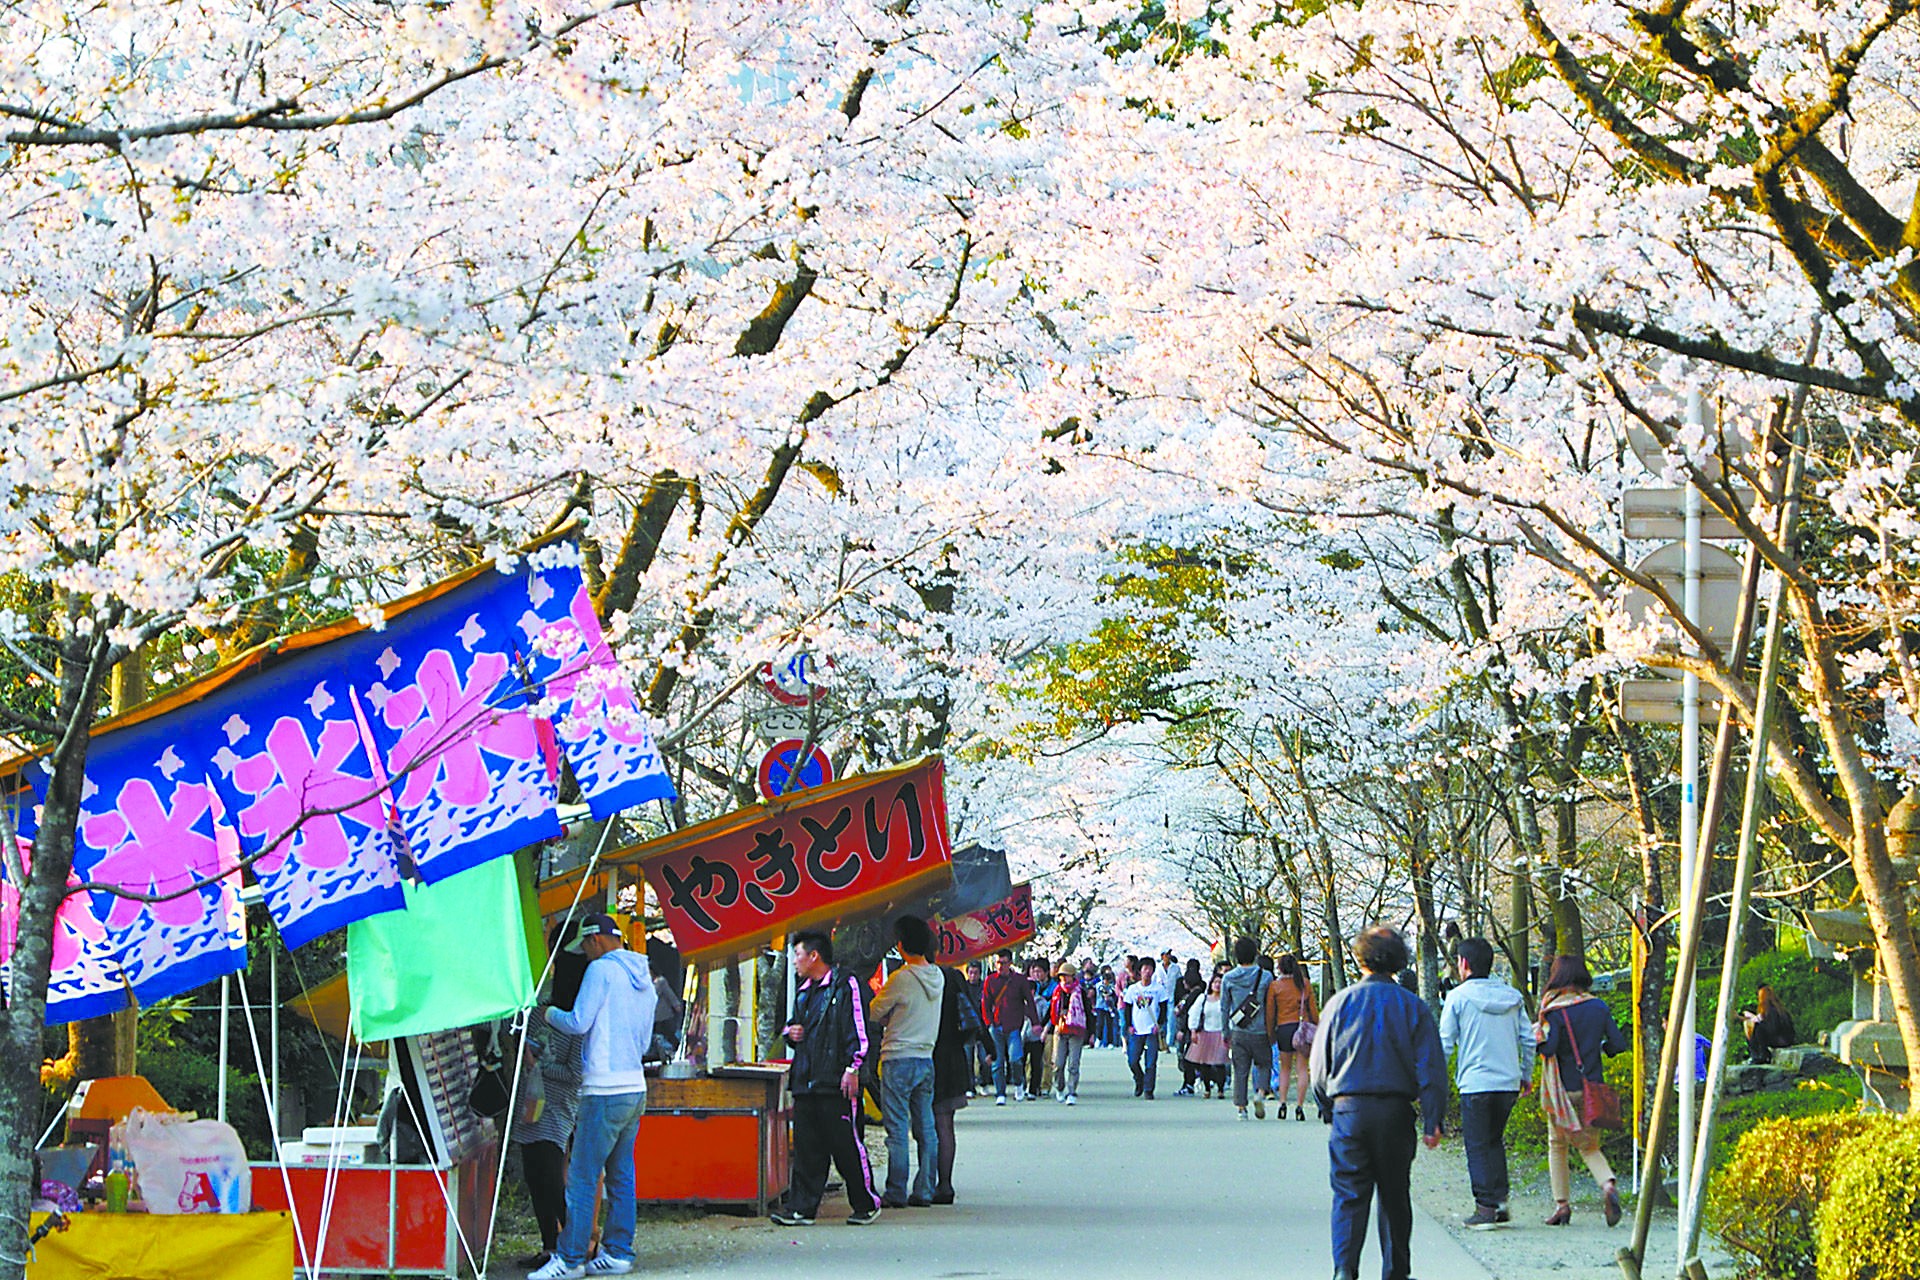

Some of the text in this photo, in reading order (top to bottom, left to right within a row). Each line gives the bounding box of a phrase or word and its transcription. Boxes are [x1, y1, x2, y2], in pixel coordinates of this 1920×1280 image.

[232, 716, 386, 871] 氷
[383, 649, 538, 808] 氷
[82, 777, 222, 928] 氷
[660, 780, 926, 934] やきとり
